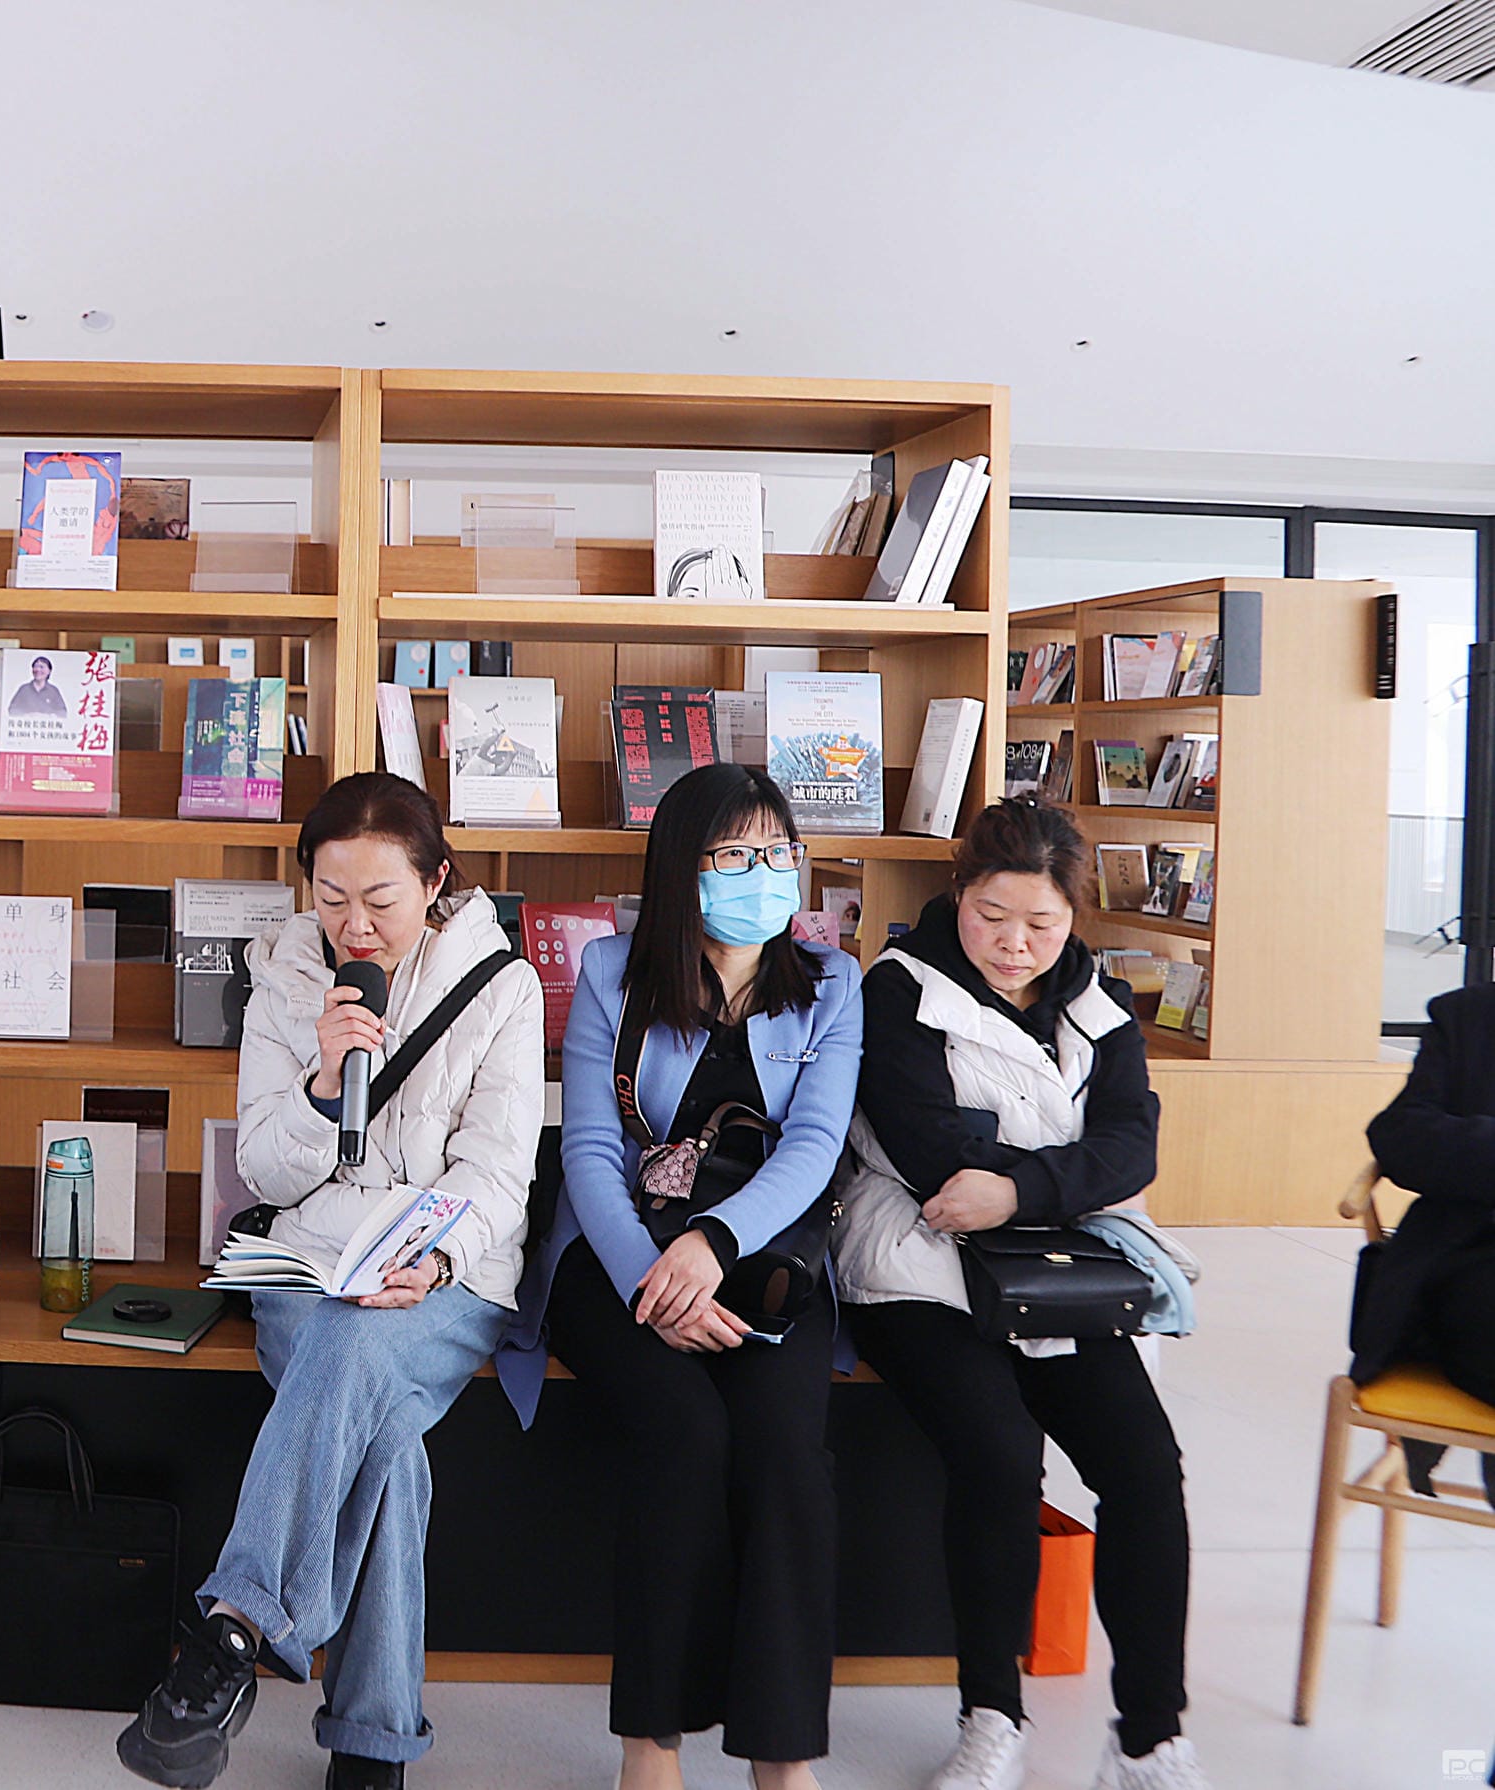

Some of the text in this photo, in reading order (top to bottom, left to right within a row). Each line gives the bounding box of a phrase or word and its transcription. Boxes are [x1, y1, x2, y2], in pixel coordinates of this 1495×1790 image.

[50, 506, 89, 516] 人类学的
[78, 651, 116, 751] 张桂梅
[792, 786, 857, 800] 城市的胜利
